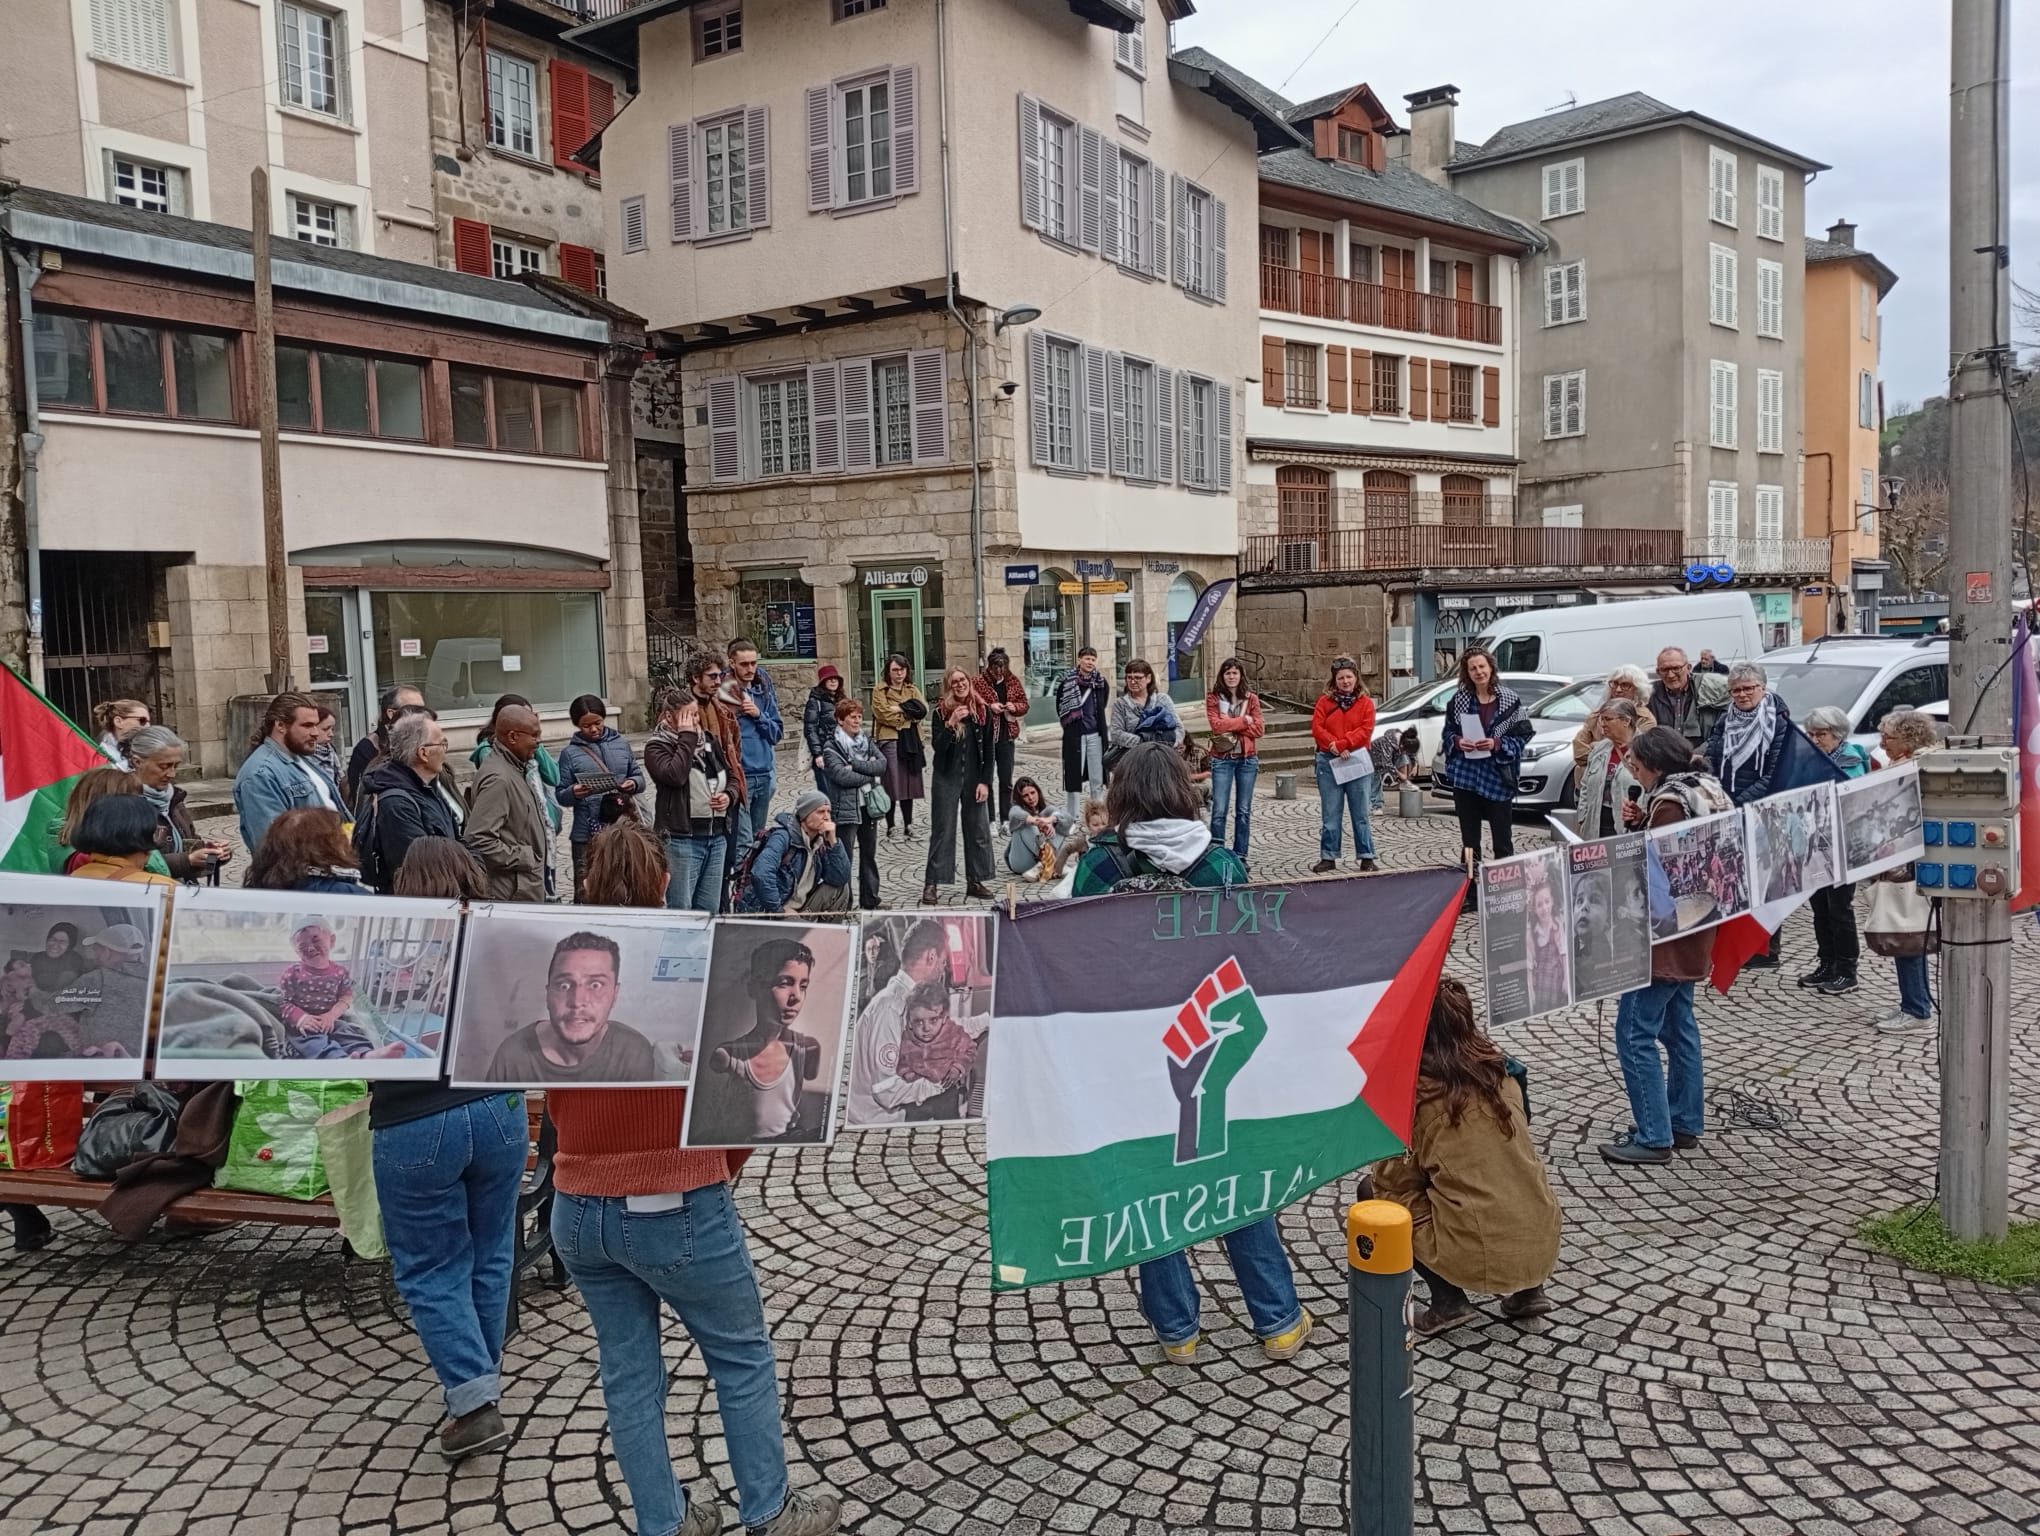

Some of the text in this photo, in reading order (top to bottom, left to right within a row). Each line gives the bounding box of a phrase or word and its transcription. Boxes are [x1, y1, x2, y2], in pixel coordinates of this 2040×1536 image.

[864, 570, 909, 585] Allianz
[1967, 586, 1992, 601] cgt
[1496, 595, 1534, 607] MESSIRE
[1031, 610, 1050, 620] Allianz
[1184, 606, 1210, 648] Allianz
[1615, 843, 1625, 851] PAS
[1625, 841, 1635, 849] QUE
[1573, 844, 1608, 863] GAZA
[1615, 848, 1642, 859] NOMBRES
[1573, 859, 1609, 872] DES VISAGES
[1487, 864, 1522, 884] GAZA
[1488, 884, 1500, 893] DES
